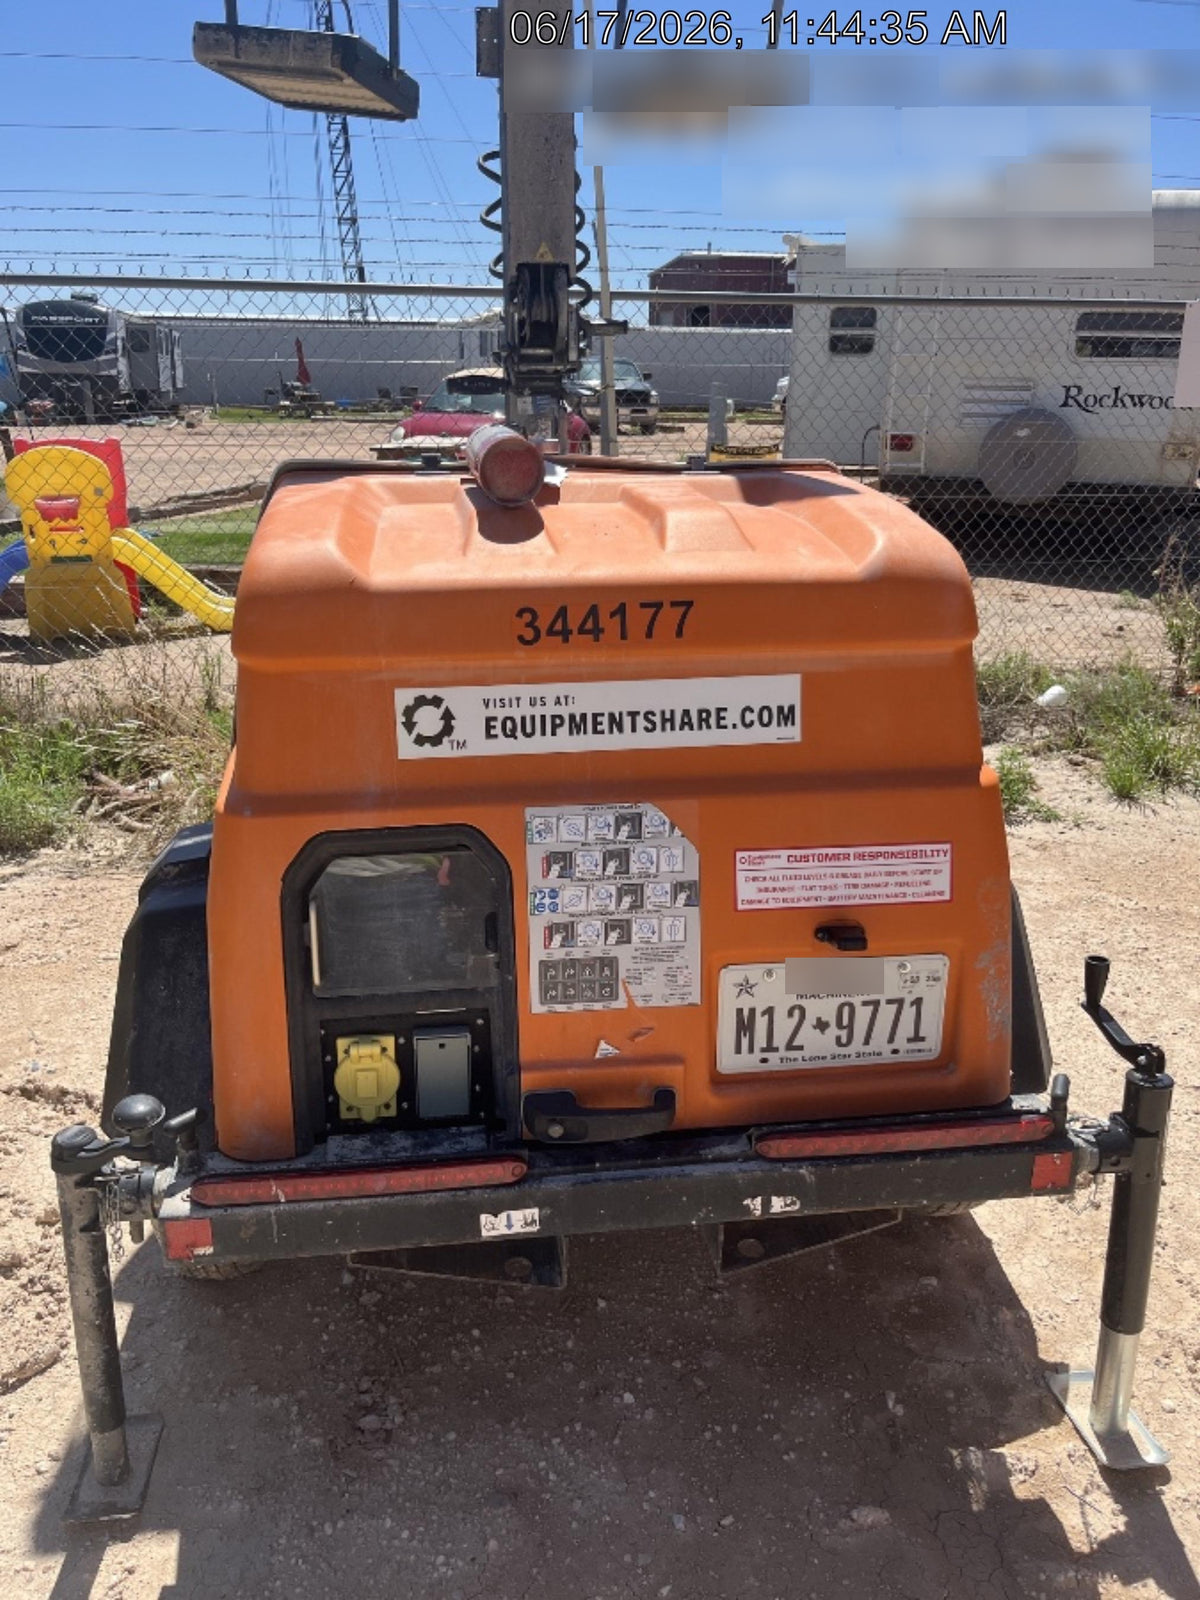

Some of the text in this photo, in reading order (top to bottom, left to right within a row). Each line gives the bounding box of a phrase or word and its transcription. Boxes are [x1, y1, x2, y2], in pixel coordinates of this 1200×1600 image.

[515, 600, 694, 646] 344177
[482, 695, 576, 709] VISIT US AT:
[484, 704, 796, 740] EQUIPMENTSHARE.COM
[449, 739, 467, 751] TM
[787, 852, 850, 863] CUSTOMER
[853, 848, 949, 861] RESPONSIBILITY
[734, 996, 927, 1055] M12 9771
[779, 1050, 883, 1064] The Lone Star State
